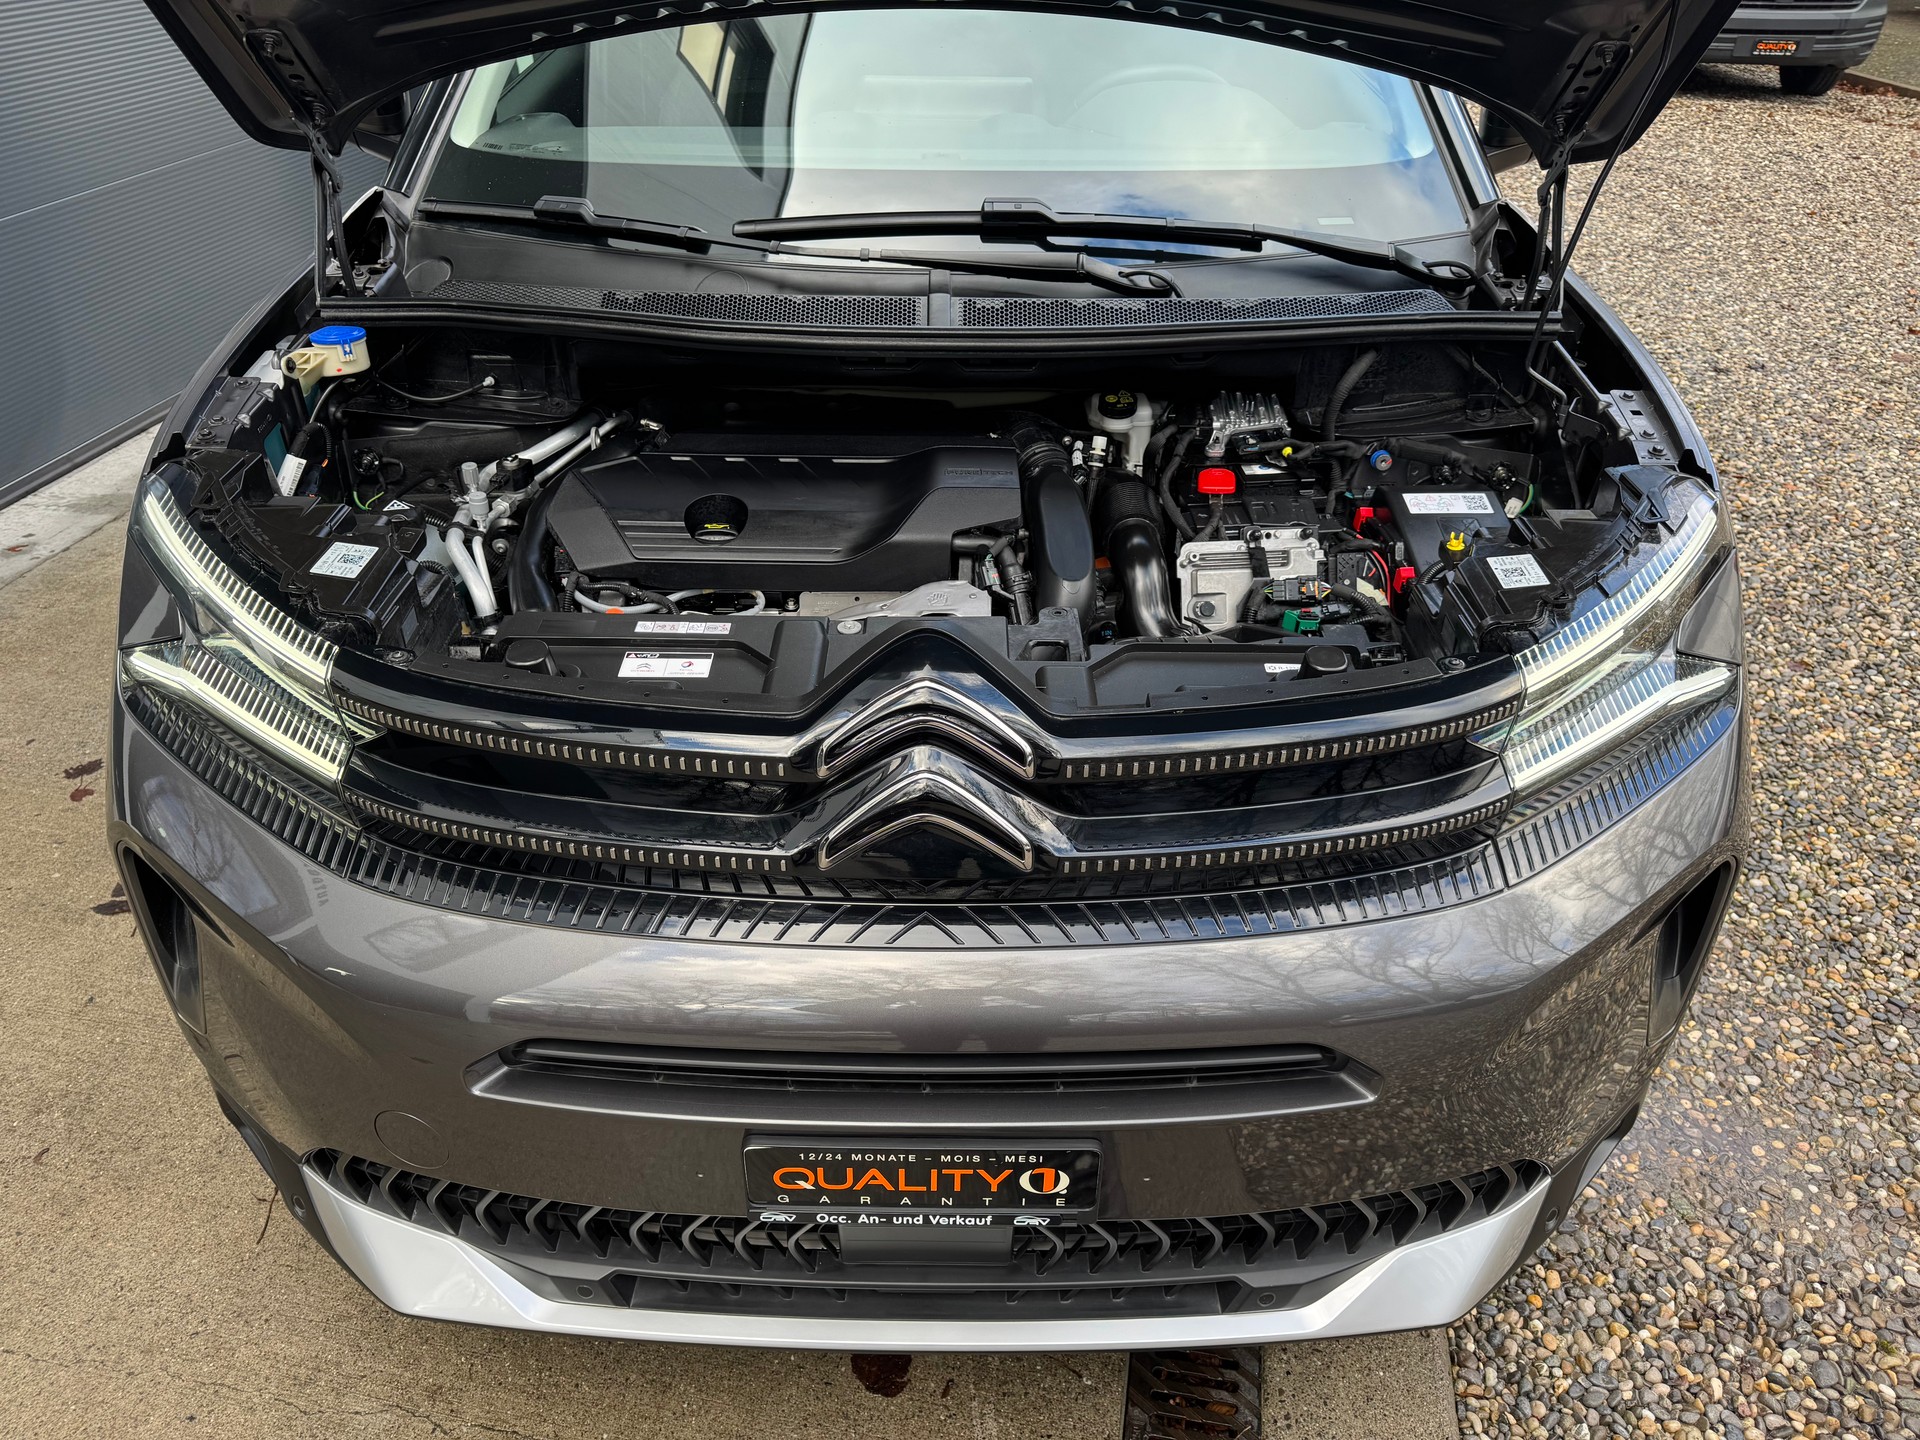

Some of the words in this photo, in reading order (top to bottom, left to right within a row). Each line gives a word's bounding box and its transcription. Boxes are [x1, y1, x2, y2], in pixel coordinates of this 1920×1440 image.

[798, 1153, 843, 1161] 12/24
[851, 1153, 917, 1162] MONATE
[940, 1155, 981, 1163] MOIS
[1004, 1155, 1043, 1163] MESI
[772, 1166, 1014, 1192] QUALITY
[777, 1194, 1066, 1207] GARANTIE
[816, 1213, 852, 1224] Occ.
[857, 1214, 887, 1224] An-
[892, 1214, 923, 1225] und
[929, 1215, 993, 1226] Verkauf
